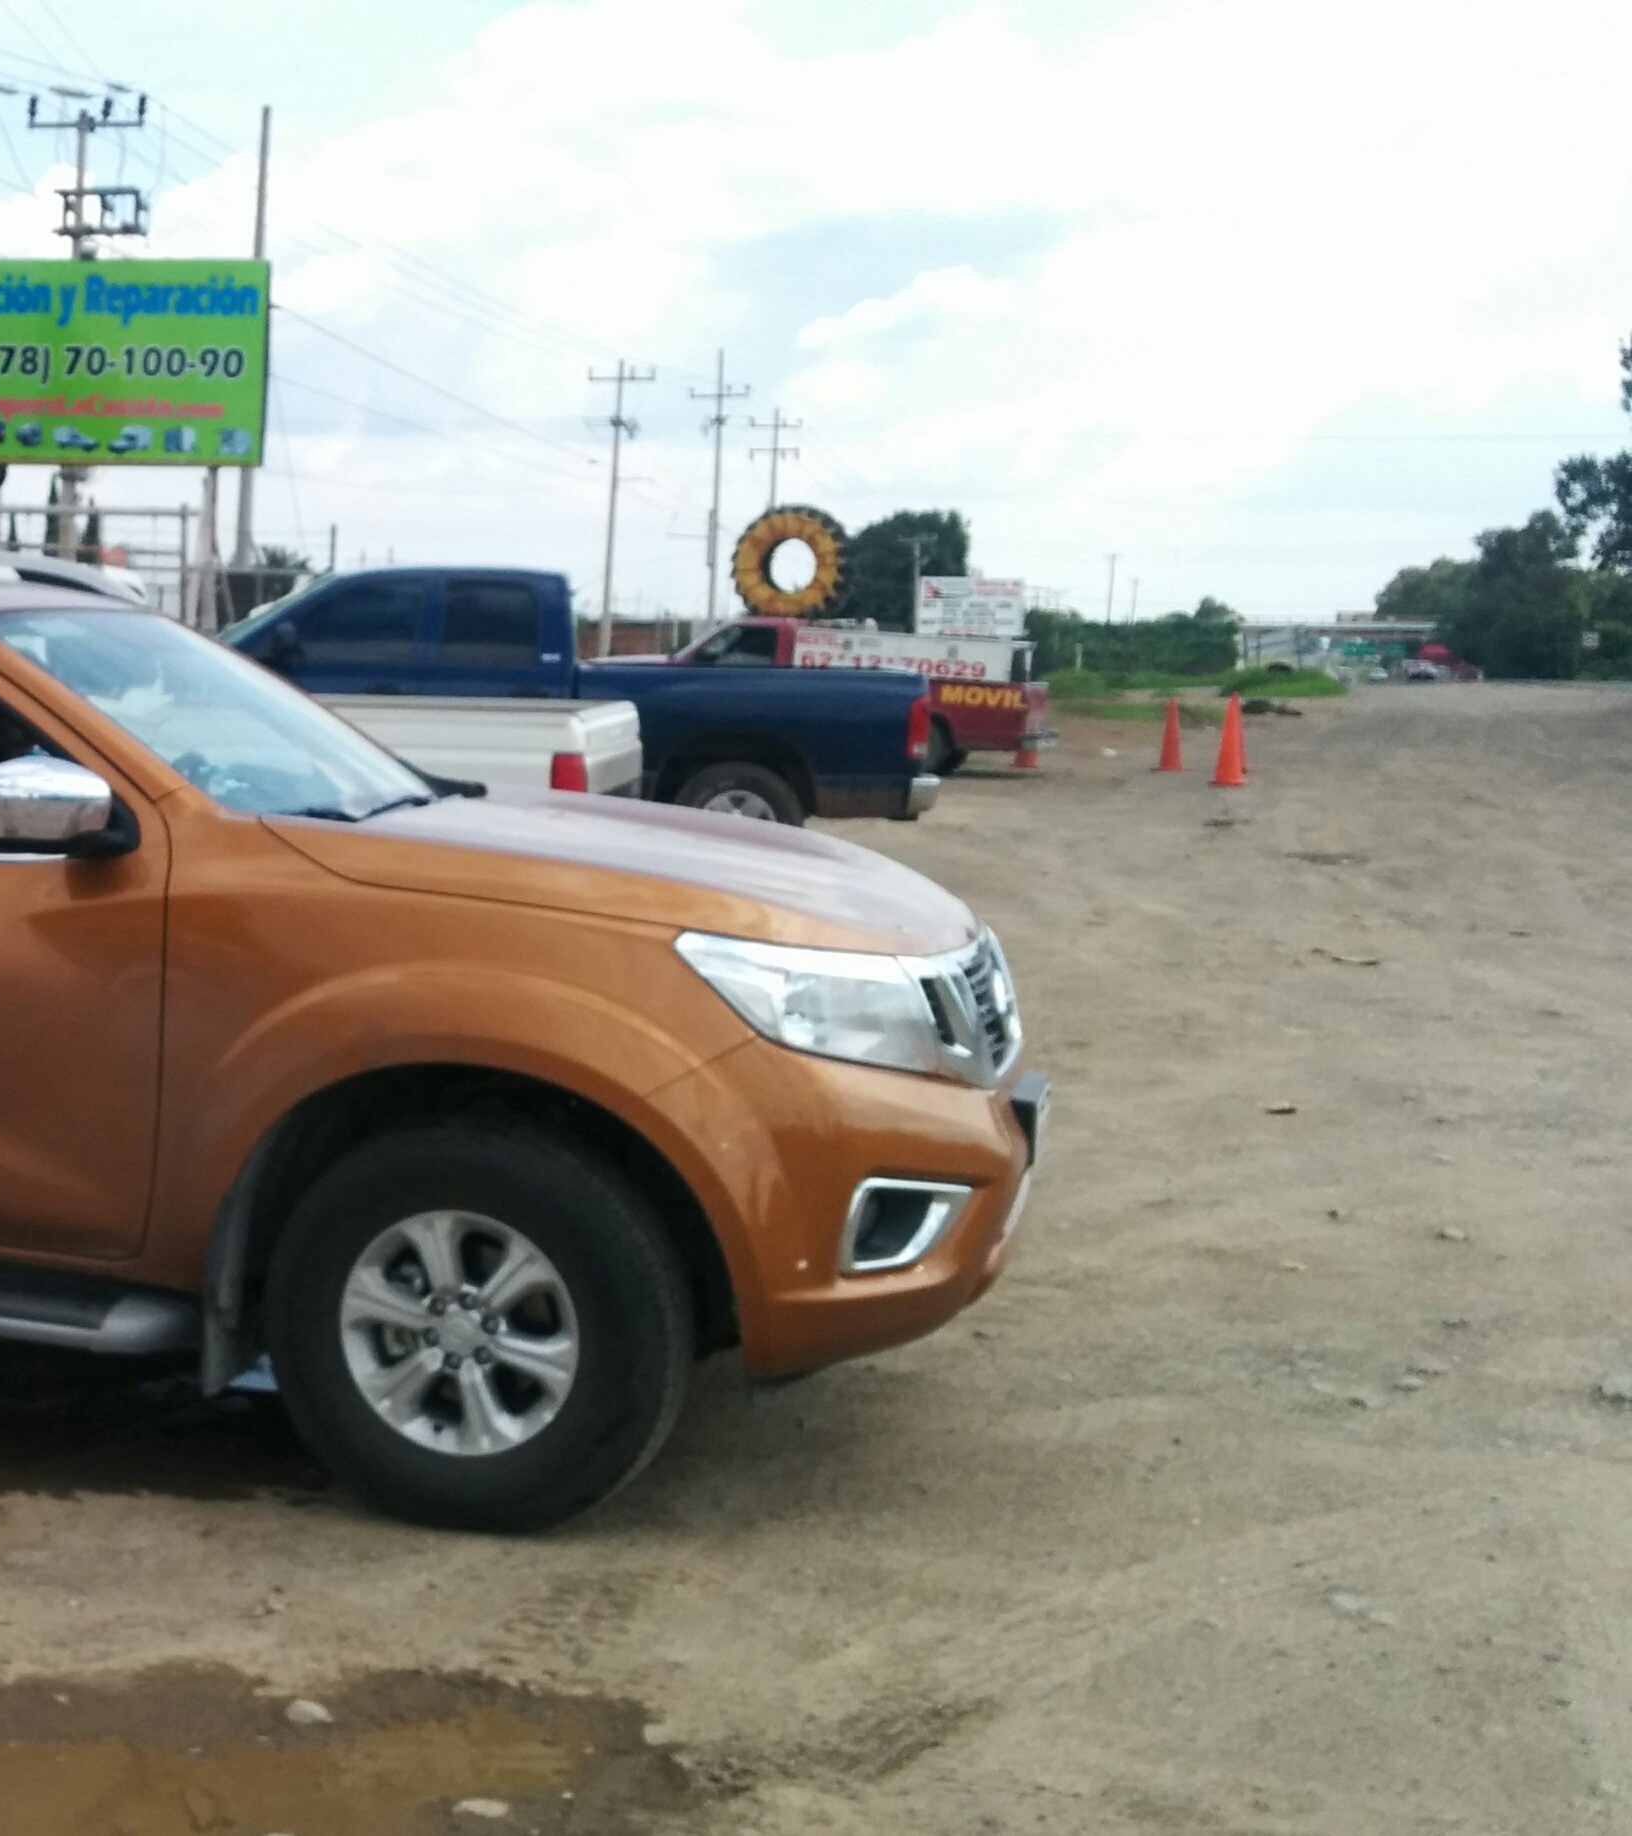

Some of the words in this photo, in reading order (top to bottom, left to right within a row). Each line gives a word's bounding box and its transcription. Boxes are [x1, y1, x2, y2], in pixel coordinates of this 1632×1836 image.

[56, 284, 77, 327] y
[85, 275, 260, 328] Reparación
[65, 346, 244, 377] 70-100-90
[940, 684, 1029, 710] MOVIL
